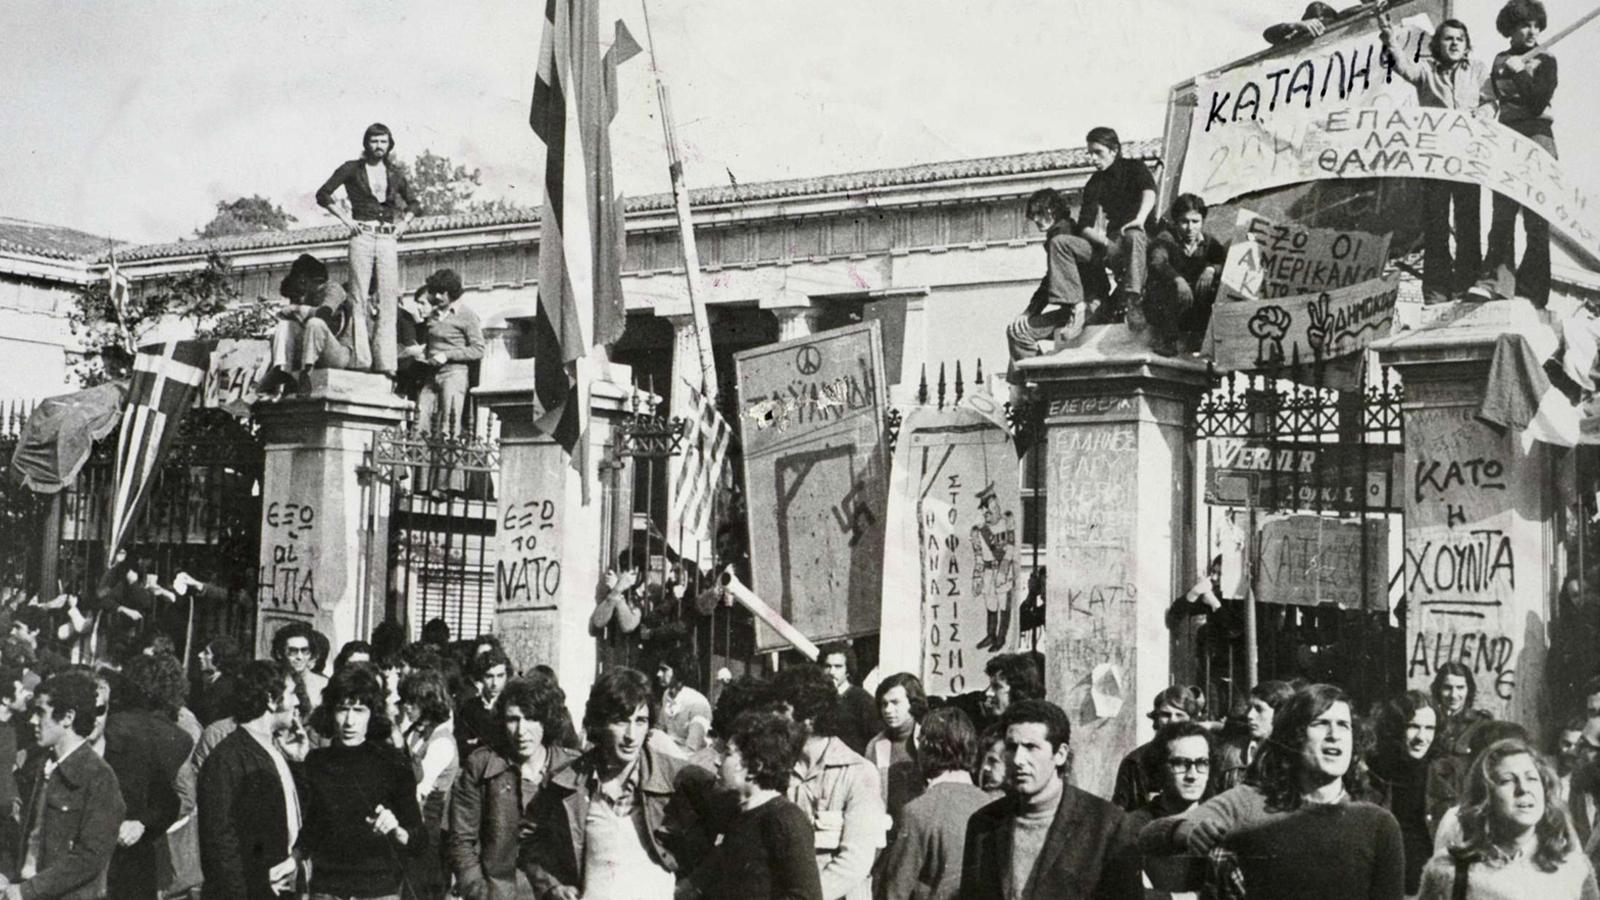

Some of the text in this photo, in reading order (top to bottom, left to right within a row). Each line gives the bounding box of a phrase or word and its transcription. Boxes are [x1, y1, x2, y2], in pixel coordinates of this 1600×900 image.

[1318, 148, 1491, 181] ΘΑΝΑΤΟΣ
[1331, 233, 1363, 262] ΟΙ
[1446, 504, 1467, 528] Η
[511, 535, 537, 552] ΤΟ
[1406, 530, 1516, 594] ΧΟΥΝΤΑ
[257, 565, 319, 610] ΗΠΑ
[496, 556, 561, 604] ΝΑΤΟ
